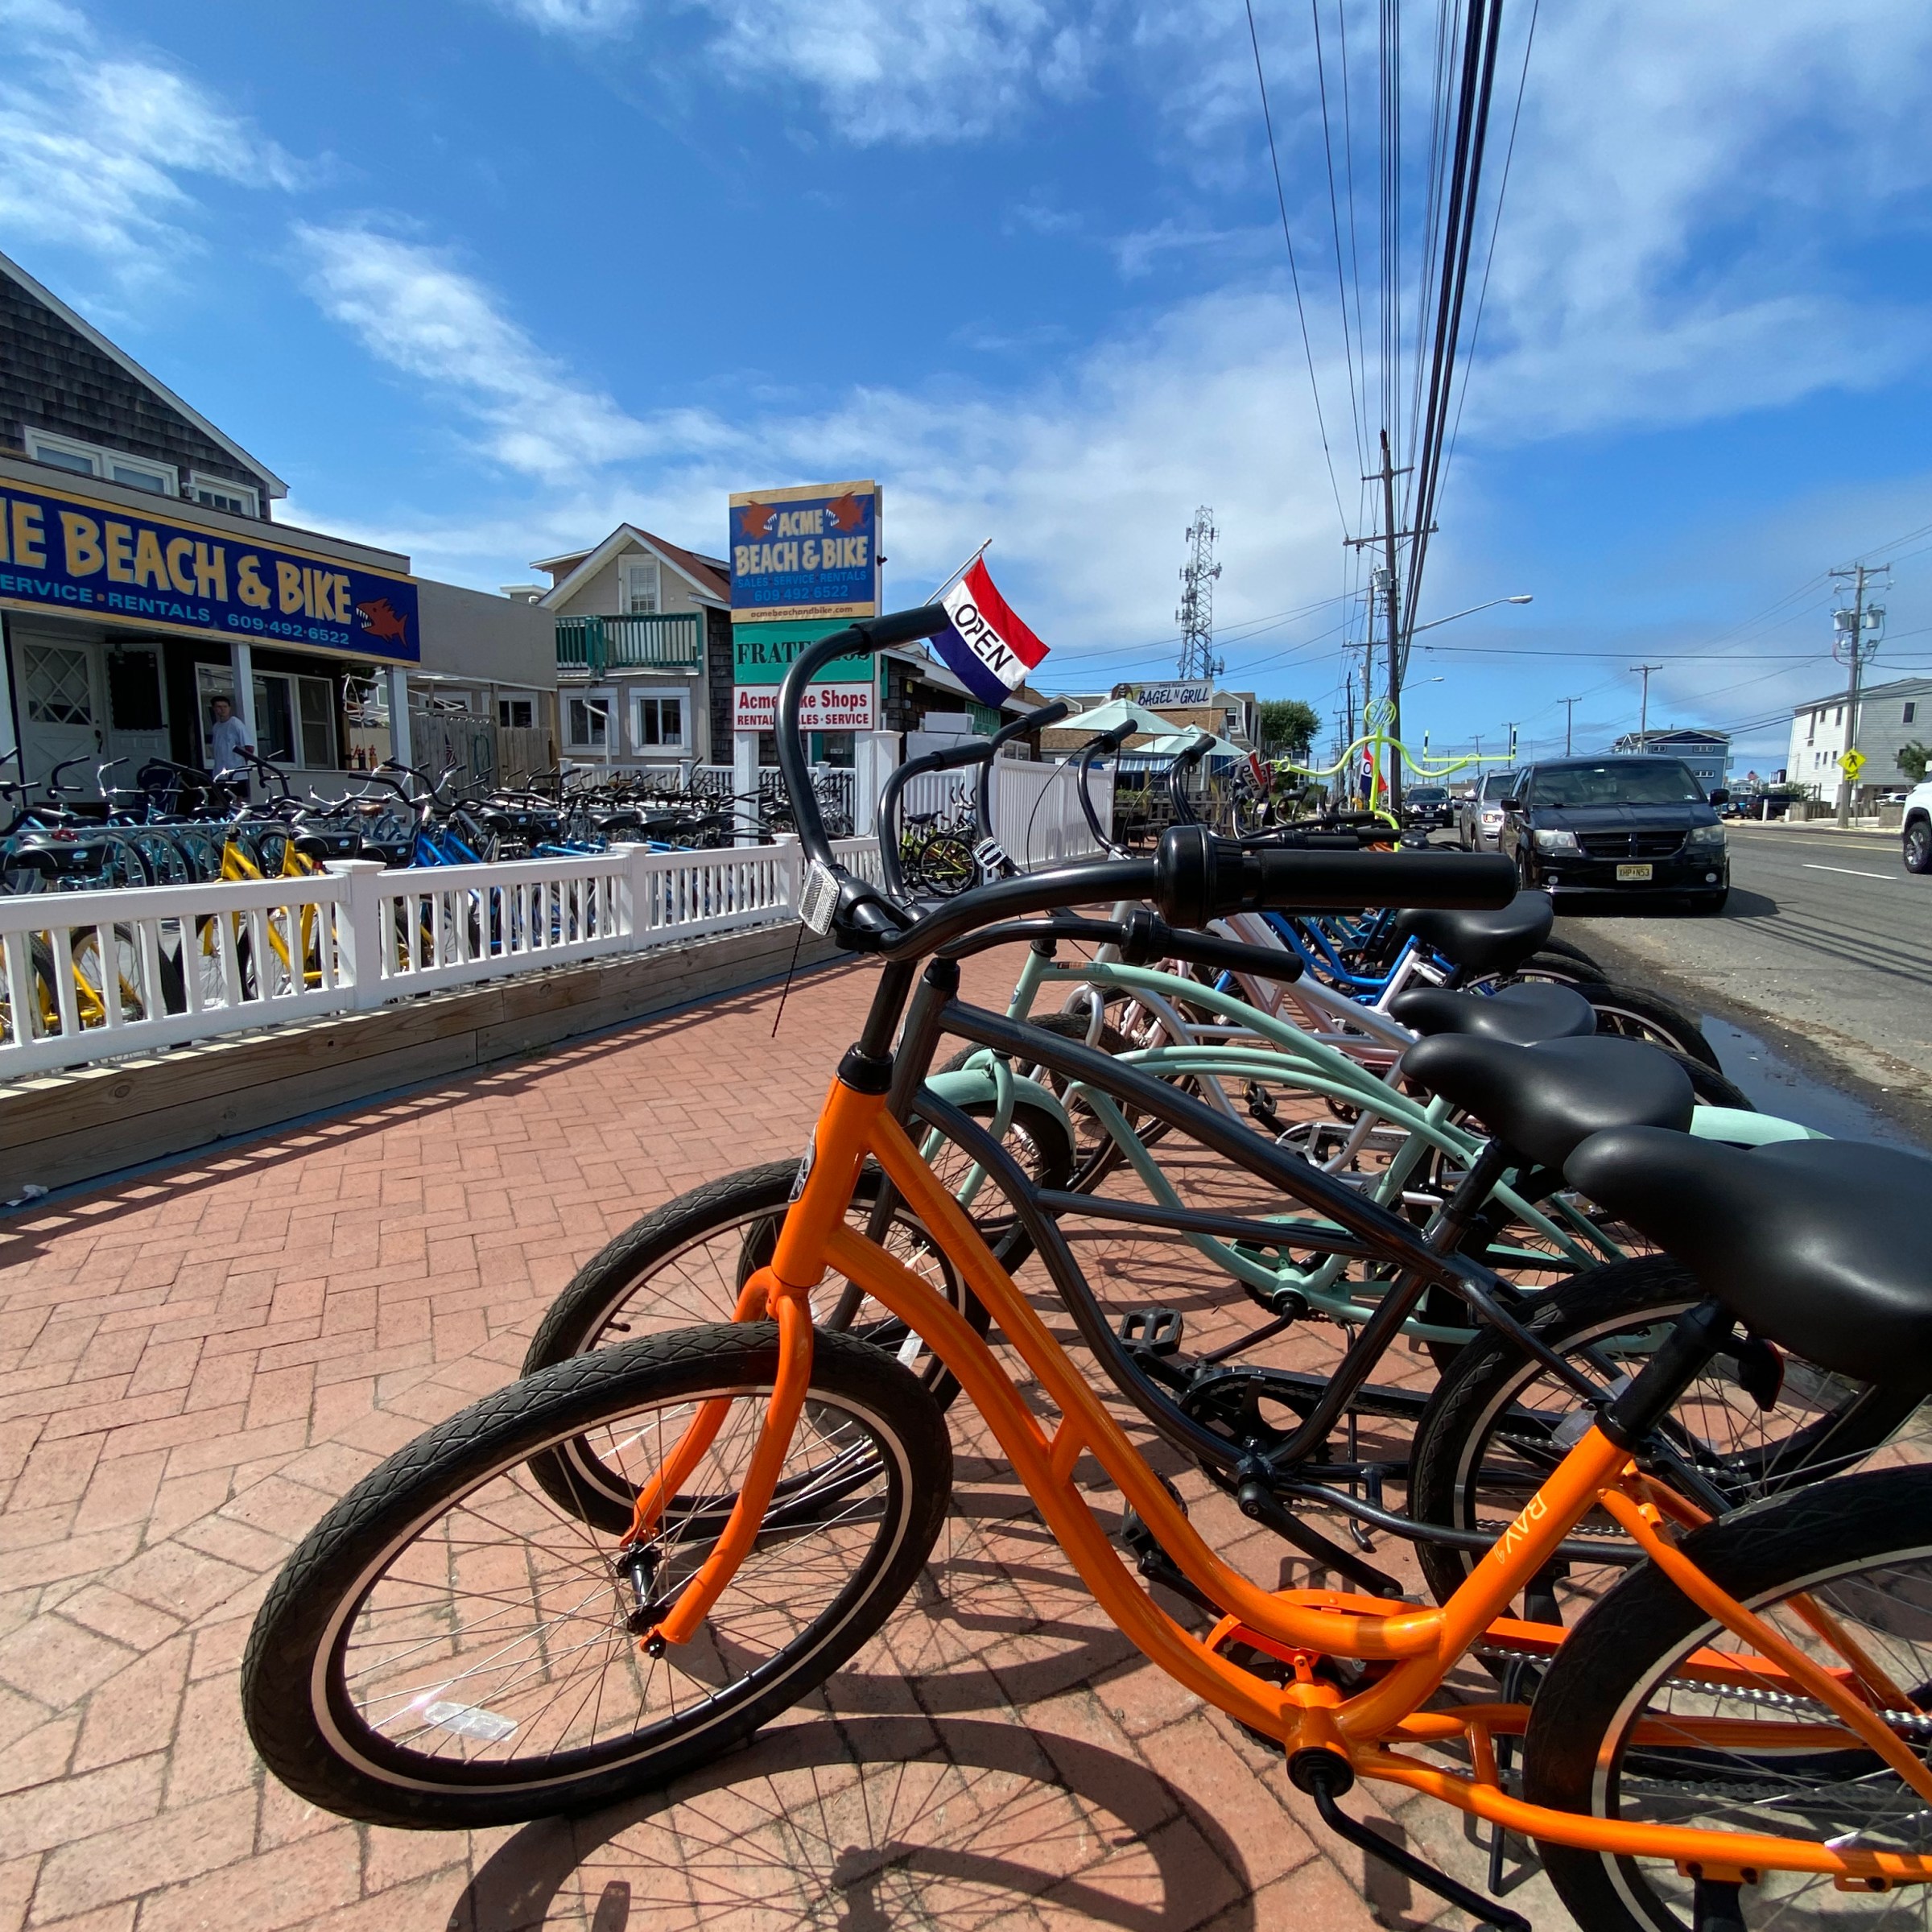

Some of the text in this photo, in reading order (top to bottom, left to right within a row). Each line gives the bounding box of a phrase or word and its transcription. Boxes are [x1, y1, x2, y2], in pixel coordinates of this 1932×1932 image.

[777, 509, 824, 539] ACME
[0, 497, 352, 625] E BEACH & BIKE
[733, 535, 869, 577] BEACH & BIKE
[737, 571, 867, 588] SALES SERVICE RENTALS
[108, 592, 210, 621] RENTALS
[750, 605, 853, 618] acmebeachandbike.com
[955, 603, 1014, 673] OPEN
[739, 691, 778, 708] Acme
[821, 689, 867, 712] Shops
[1137, 687, 1209, 706] BAGEL N GRILL
[737, 715, 774, 725] RENTAL
[825, 713, 869, 724] SERVICE
[1241, 765, 1261, 791] OPEN
